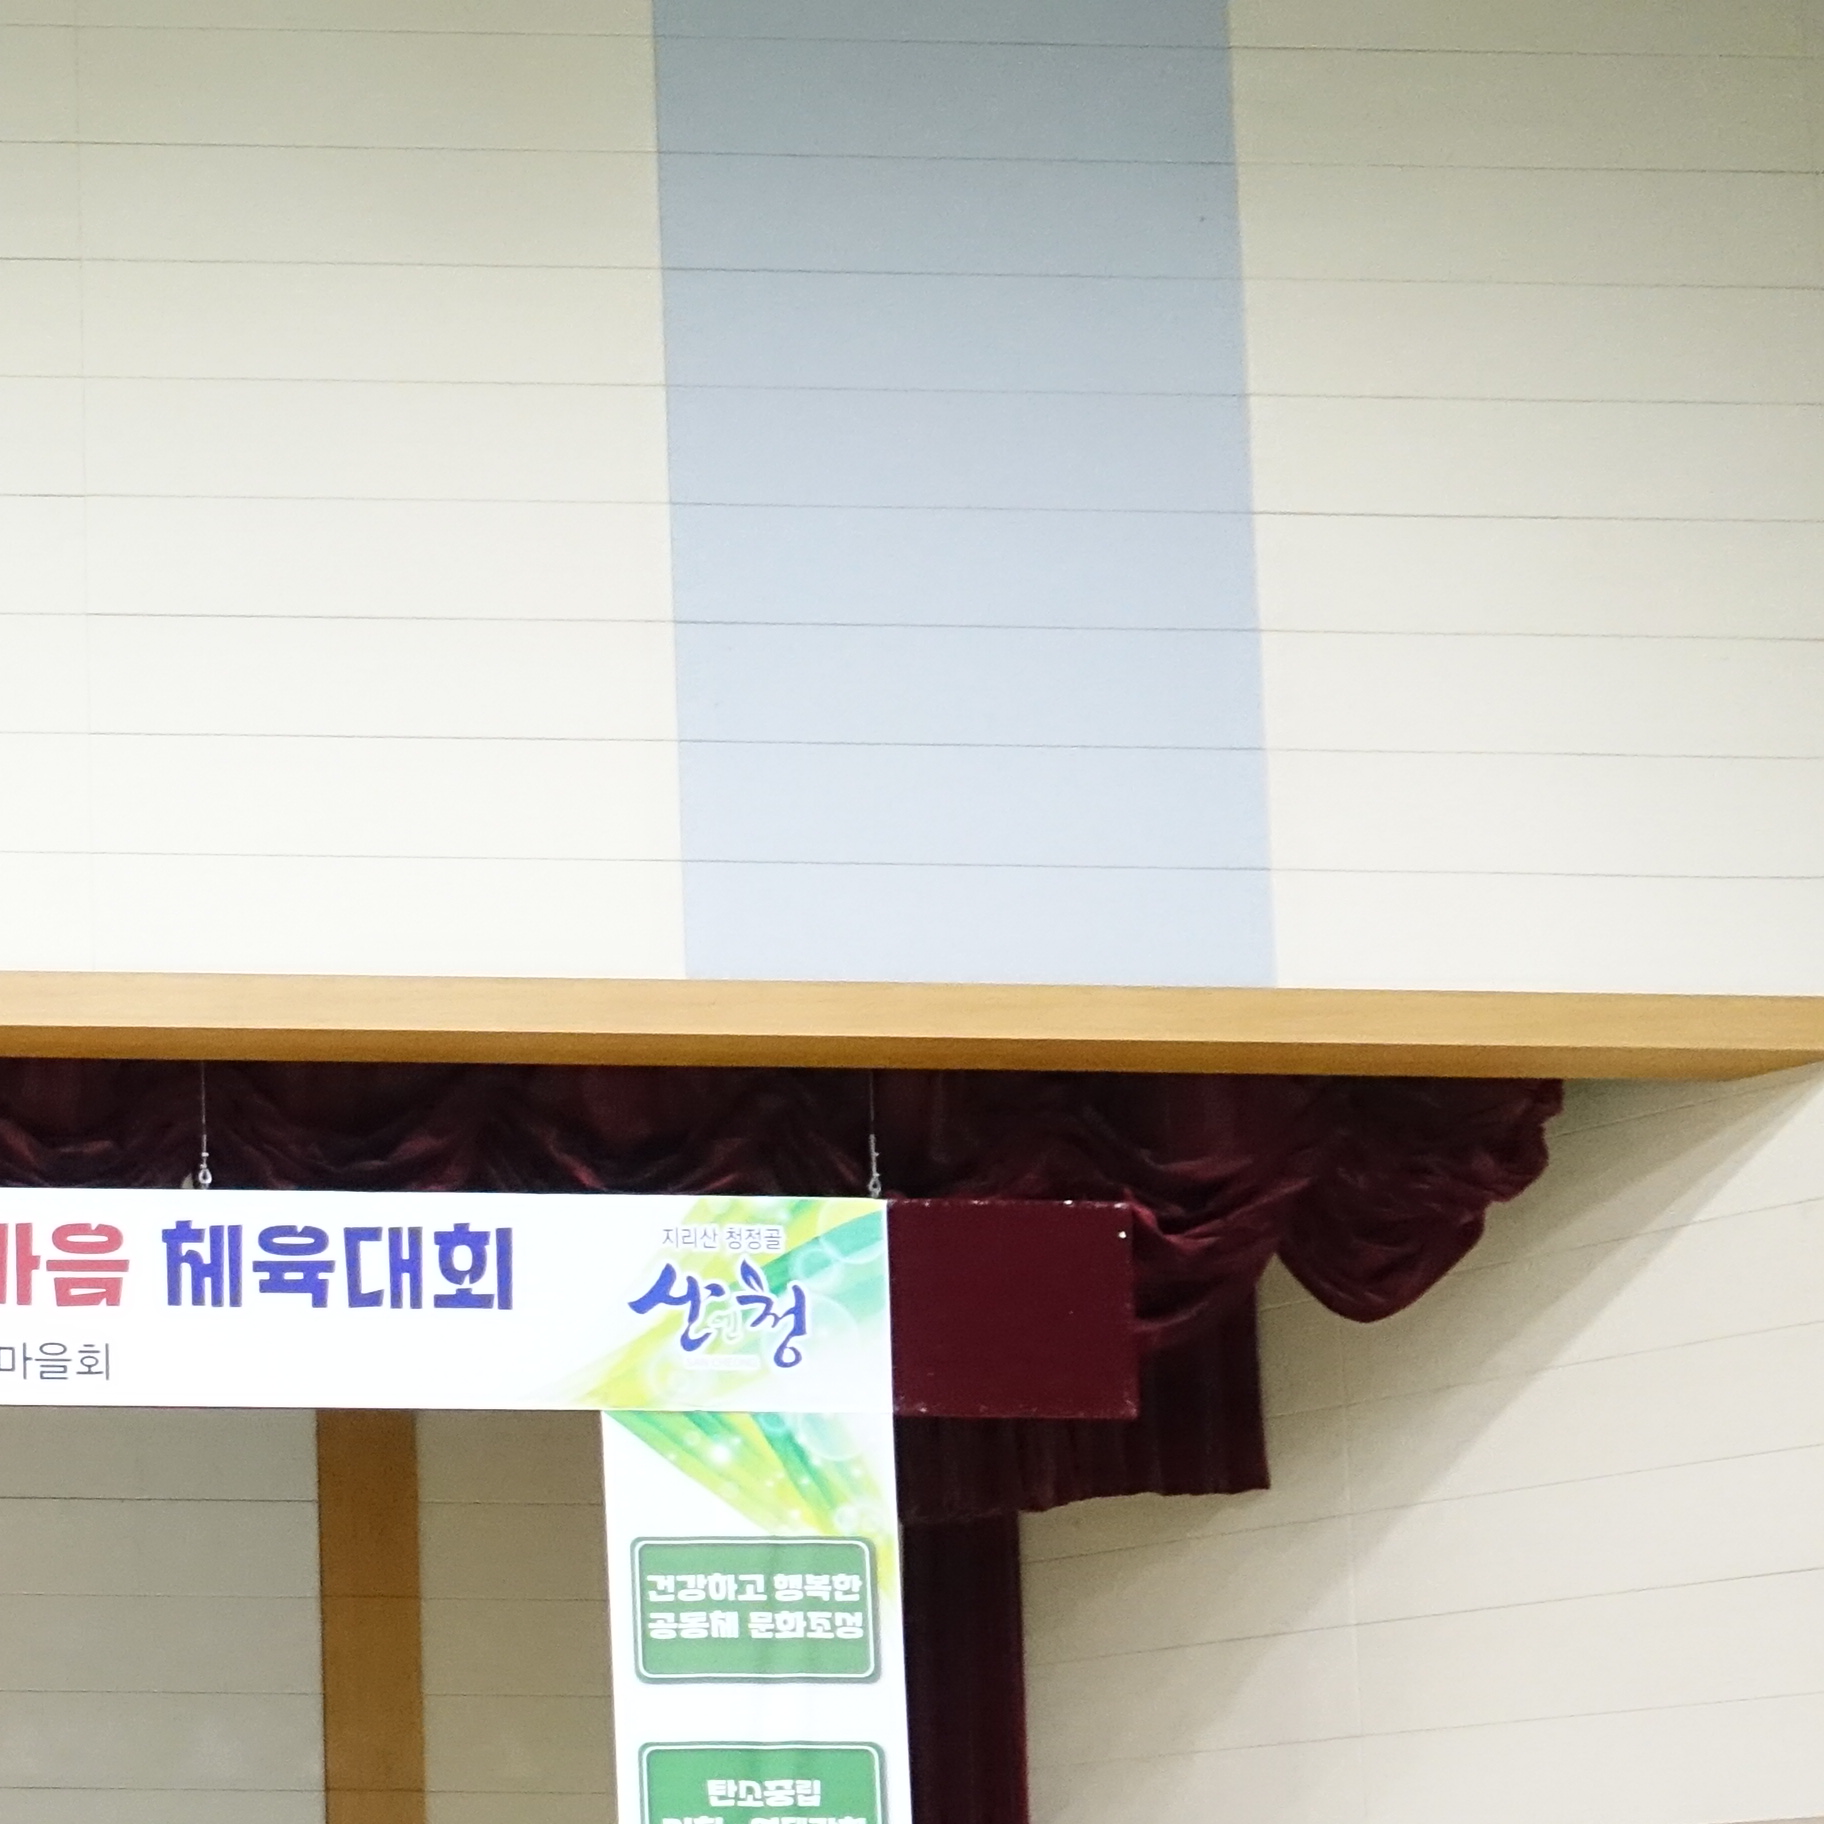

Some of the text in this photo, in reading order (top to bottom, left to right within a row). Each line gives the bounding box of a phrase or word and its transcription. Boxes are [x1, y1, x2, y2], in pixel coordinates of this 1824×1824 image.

[661, 1226, 782, 1251] 지리산 청정골
[161, 1218, 514, 1312] 체육대회
[645, 1572, 863, 1602] 건강하고 행복한
[647, 1609, 864, 1640] 공동체 문화조성
[705, 1778, 821, 1808] 탄소중립
